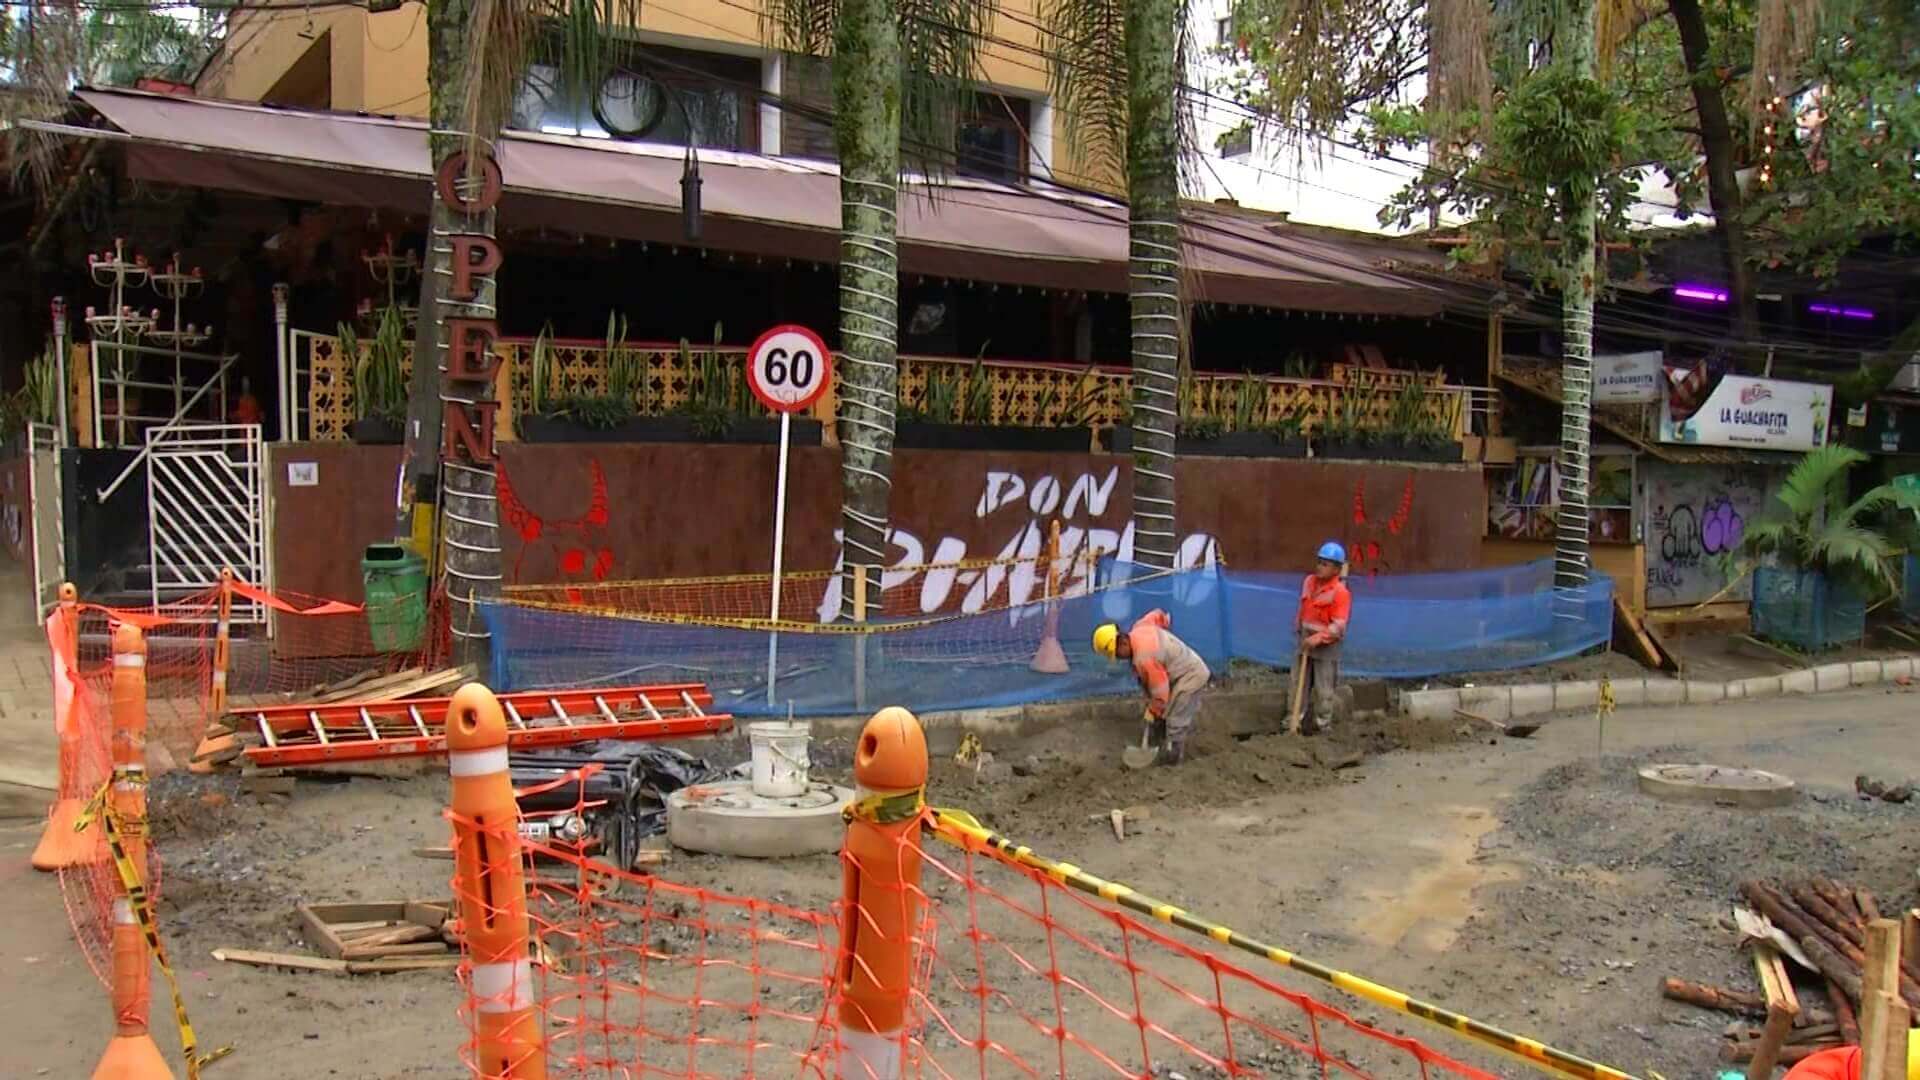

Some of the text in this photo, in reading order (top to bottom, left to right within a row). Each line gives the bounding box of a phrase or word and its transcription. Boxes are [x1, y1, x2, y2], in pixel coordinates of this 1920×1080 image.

[437, 152, 502, 461] OPEN
[764, 347, 814, 389] 60
[1720, 408, 1731, 423] LA
[976, 464, 1120, 519] DON
